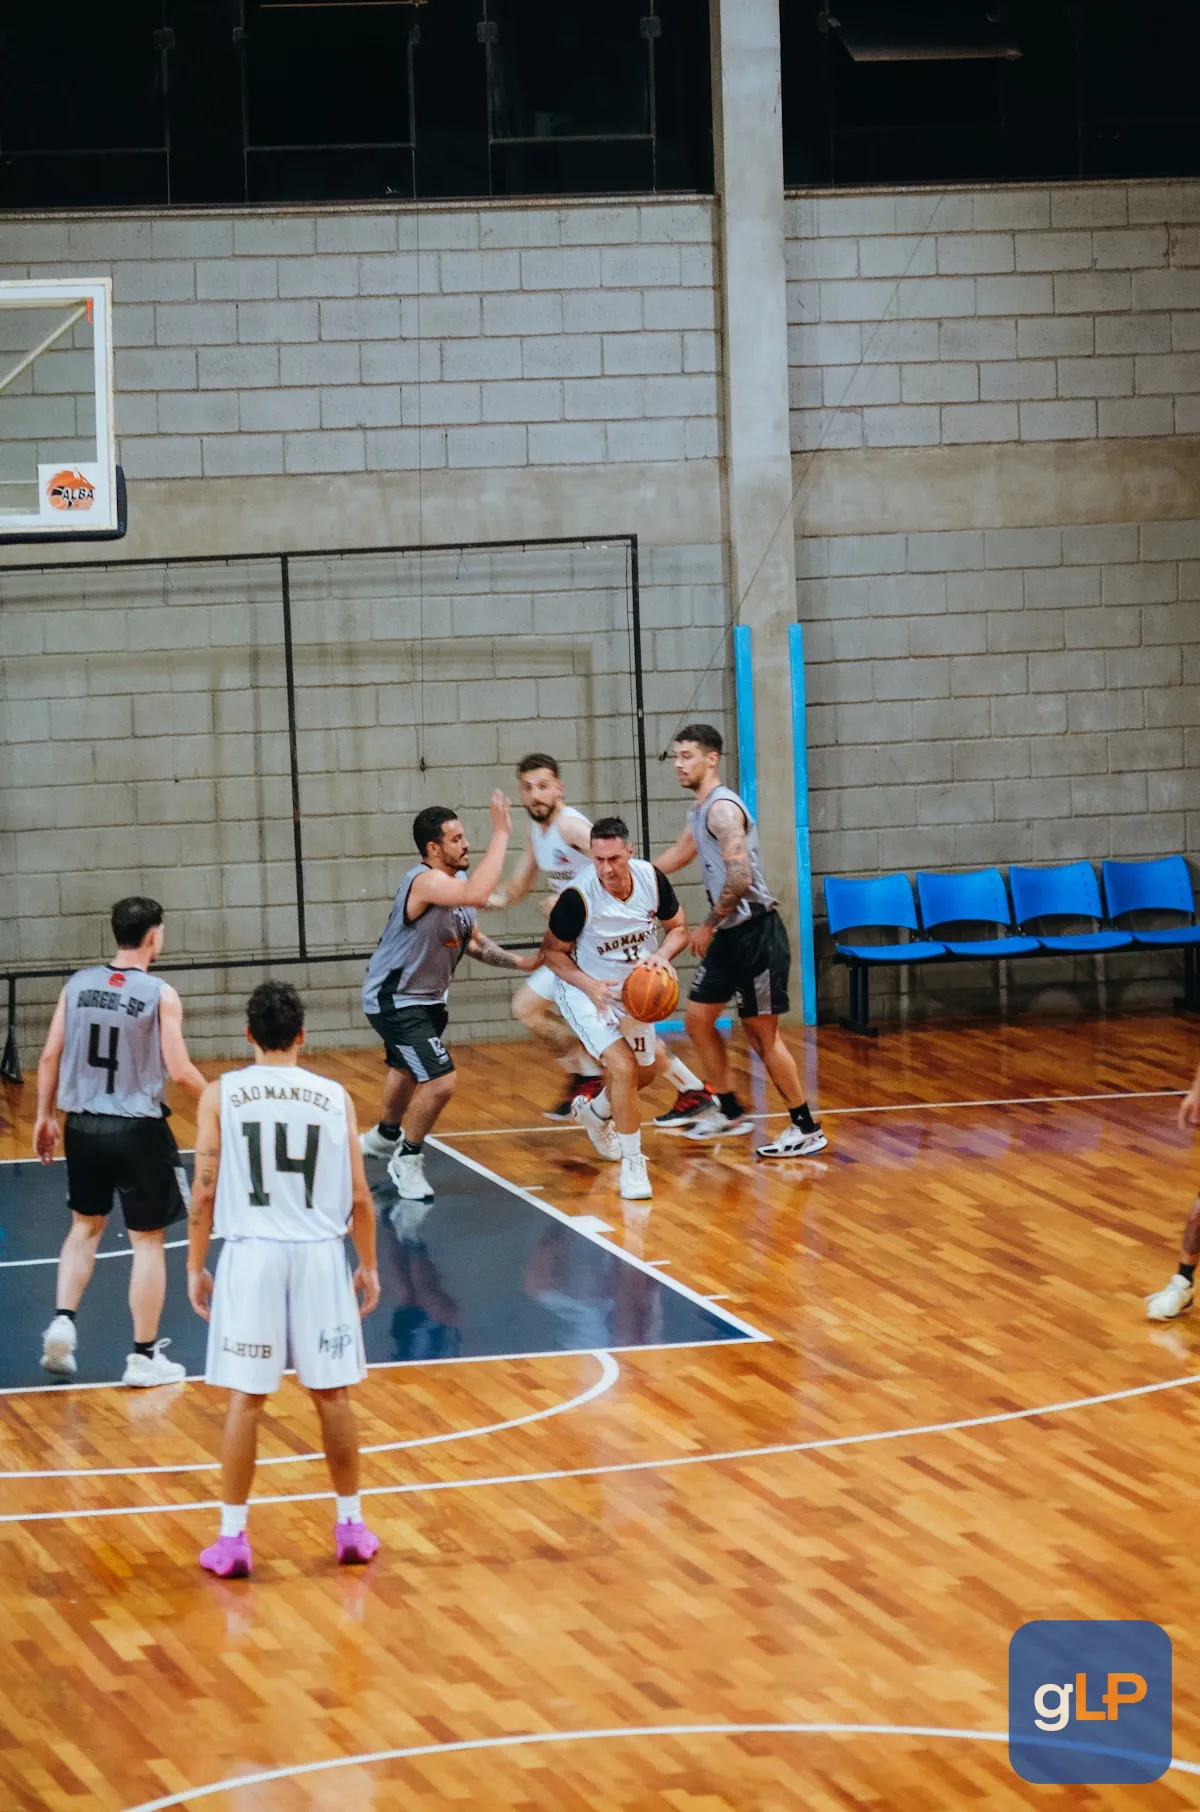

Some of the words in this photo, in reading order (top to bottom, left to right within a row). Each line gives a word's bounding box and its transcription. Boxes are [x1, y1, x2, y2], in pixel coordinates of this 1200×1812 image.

[62, 488, 95, 500] ALBA
[88, 1023, 119, 1094] 4
[264, 1086, 330, 1112] MANUEL
[242, 1121, 321, 1209] 14
